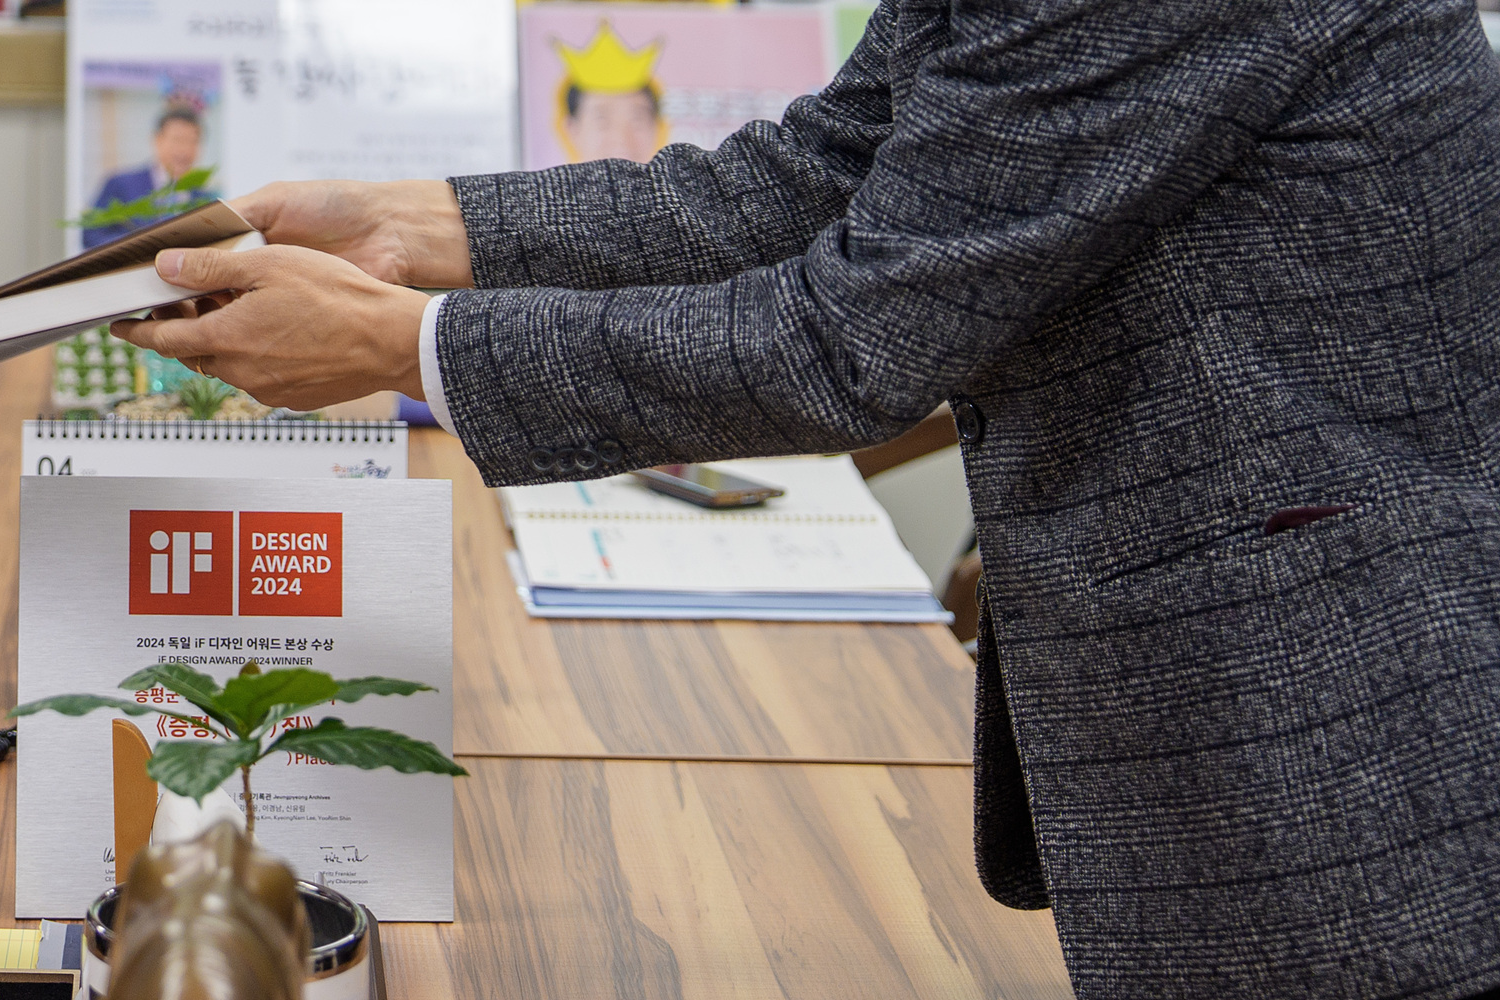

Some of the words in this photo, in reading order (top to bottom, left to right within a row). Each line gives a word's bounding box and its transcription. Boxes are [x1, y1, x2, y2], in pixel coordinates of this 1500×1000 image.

[251, 532, 328, 551] DESIGN
[250, 555, 332, 573] AWARD
[251, 577, 302, 595] 2024
[136, 638, 165, 648] 2024
[168, 637, 191, 649] 독일
[194, 638, 206, 648] iF
[208, 637, 243, 650] 디자인
[246, 638, 281, 650] 어워드
[284, 638, 308, 651] 본상
[311, 638, 334, 651] 수상
[158, 655, 167, 664] iF
[169, 656, 207, 665] DESIGN
[208, 656, 246, 665] AWARD
[271, 656, 313, 666] WINNER
